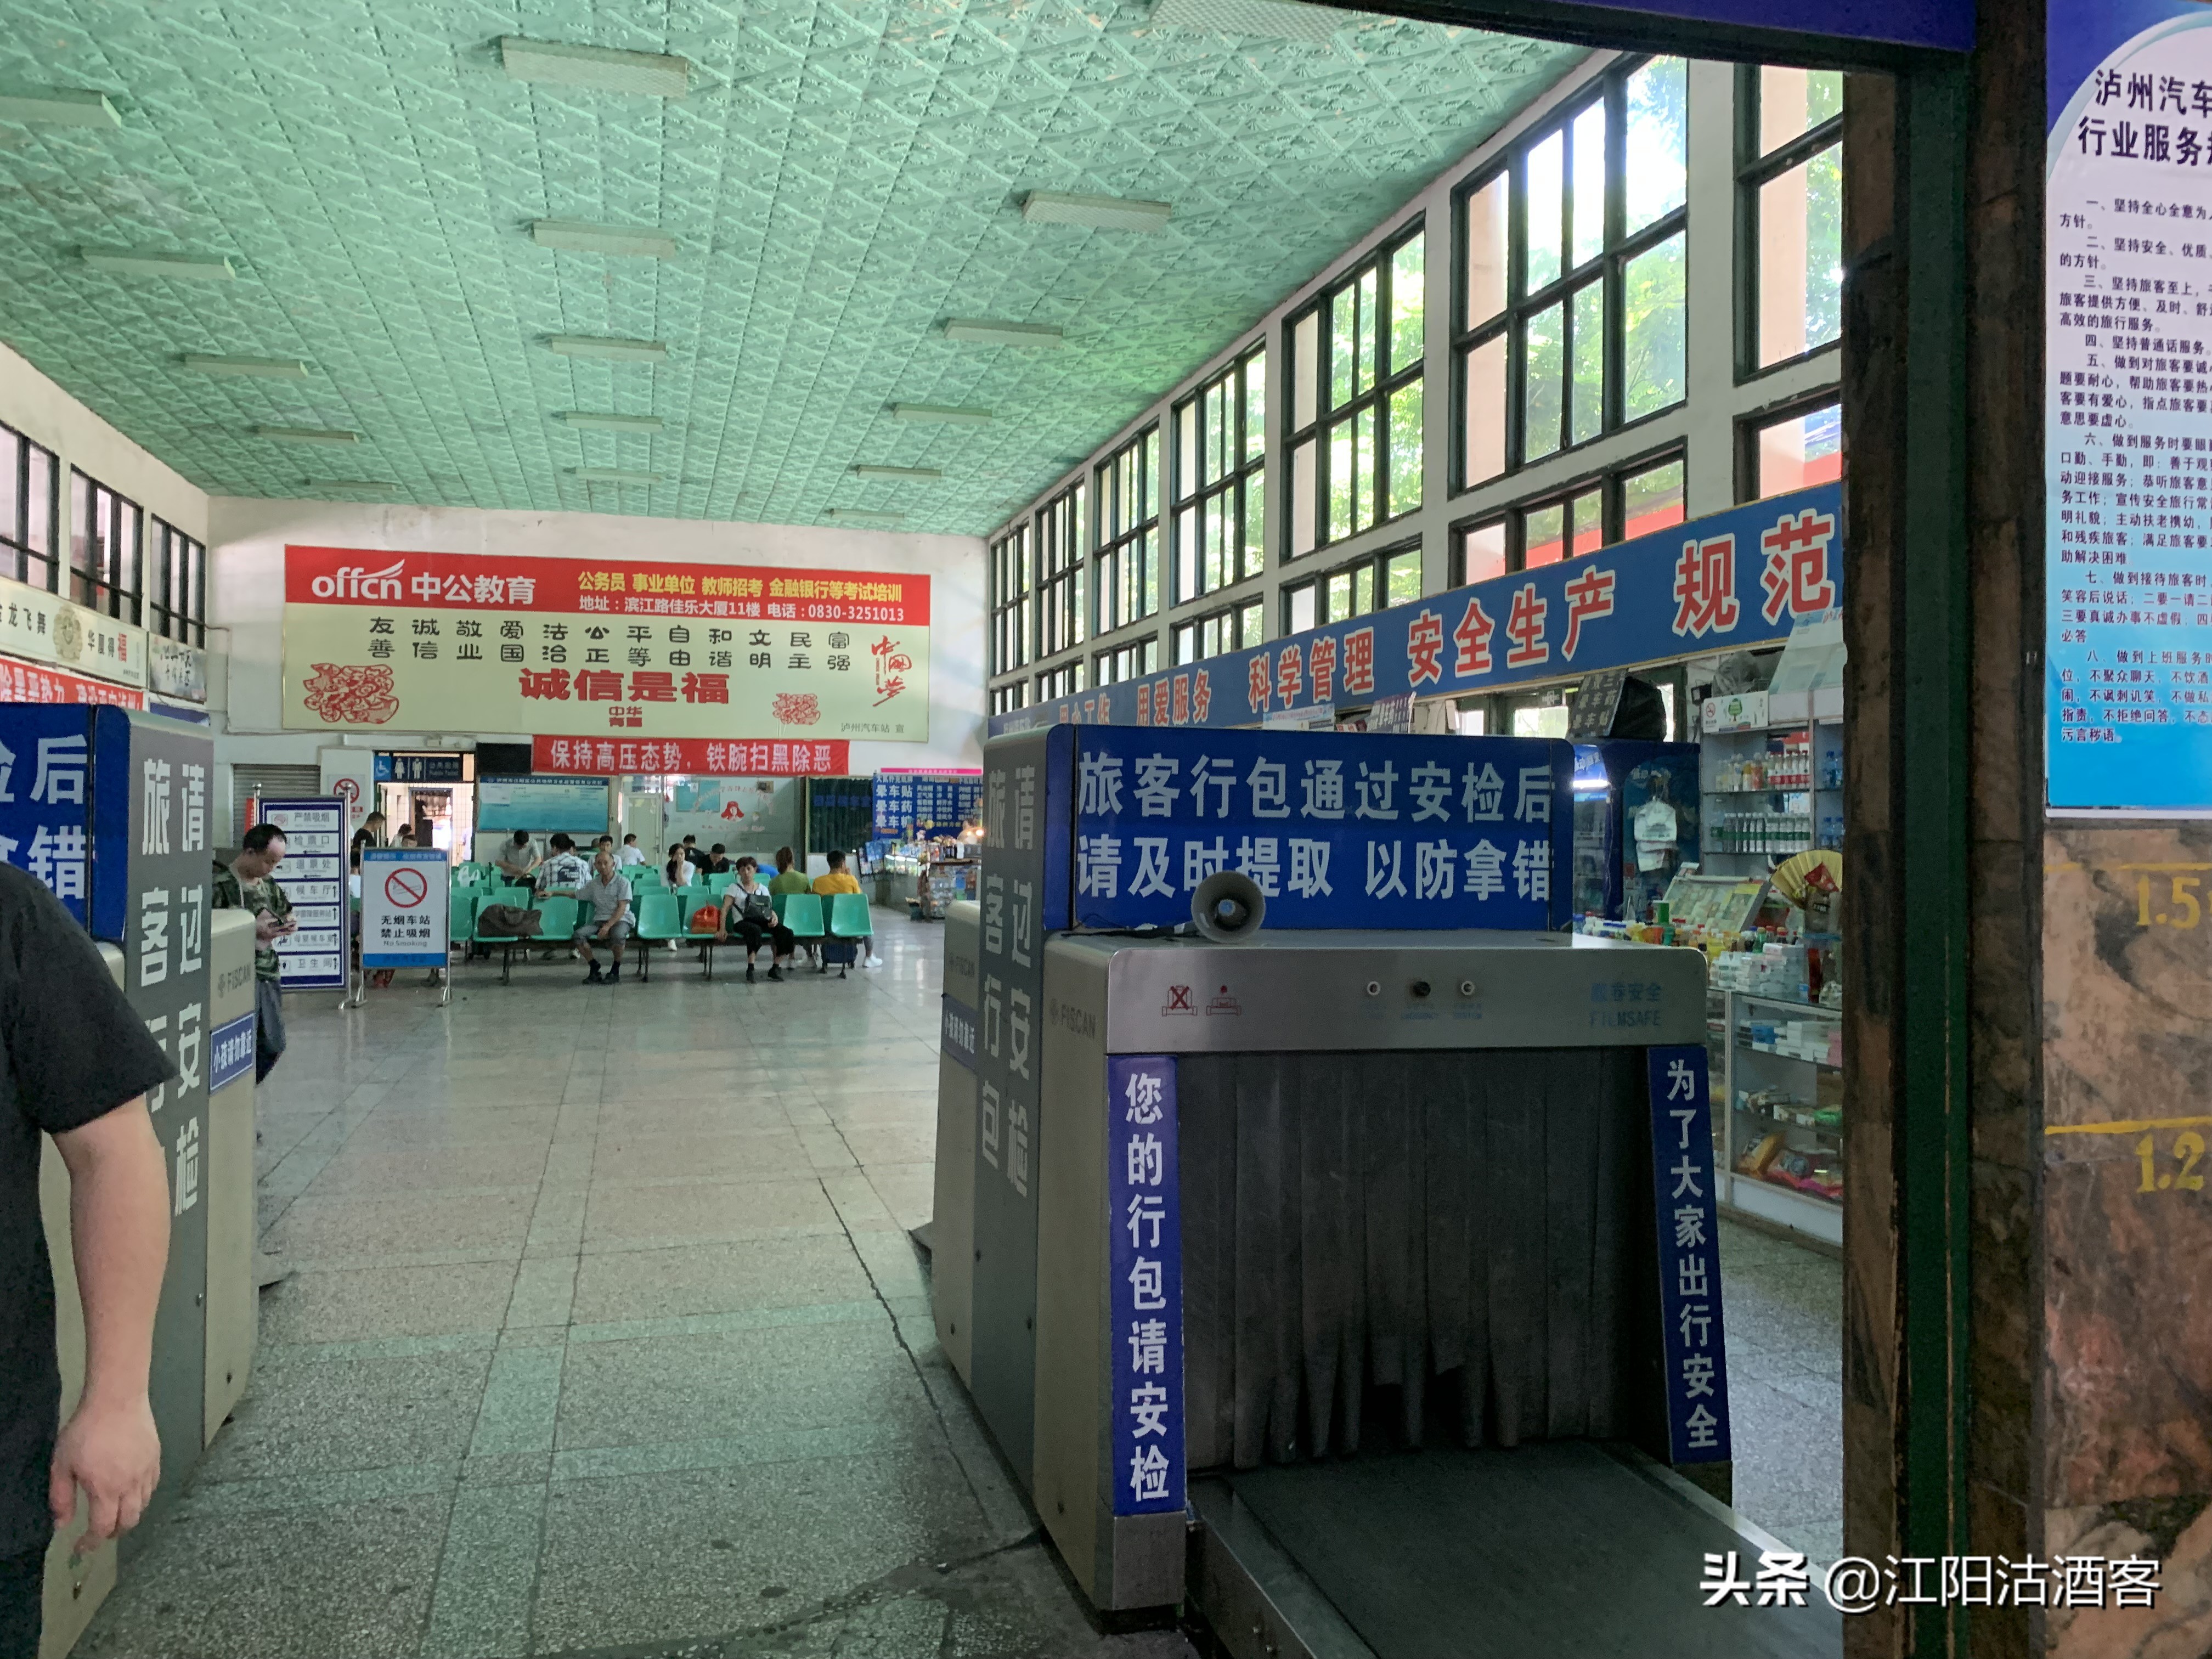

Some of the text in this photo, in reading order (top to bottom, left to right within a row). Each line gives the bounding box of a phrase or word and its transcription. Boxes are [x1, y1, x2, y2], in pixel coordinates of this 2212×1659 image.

[2095, 68, 2212, 119] 泸州汽车
[2078, 115, 2212, 166] 行业服务
[2086, 198, 2212, 219] 一、坚持全心全意为
[2059, 292, 2212, 317] 旅客提供方便、及时、舒
[2087, 353, 2212, 374] 五、做到对旅客要诚
[2060, 371, 2212, 393] 题要耐心，帮助旅客要热
[2060, 391, 2212, 413] 客要有爱心，指点旅客要
[2061, 451, 2212, 471] 口勤、手勤，即：善于观
[2061, 470, 2212, 490] 动迎接服务；恭听旅客意
[2062, 489, 2212, 510] 务工作；宣传安全旅行常
[2061, 509, 2212, 530] 明礼貌；主动扶老携幼，
[2062, 529, 2212, 549] 和残疾旅客；满足旅客要
[312, 558, 405, 600] offcn
[1672, 507, 1836, 639] 规范
[411, 572, 535, 605] 中公教育
[578, 572, 902, 602] 公务员 事业单位 教师招考 金融银行等考试培训
[2062, 589, 2212, 607] 笑容后说话；二要一请二
[1406, 564, 1616, 689] 安全生产
[2062, 609, 2212, 626] 三要真诚办事不虚假；四
[2062, 629, 2086, 644] 必答
[1249, 626, 1374, 713] 科学管理
[519, 668, 730, 704] 诚信是福
[1137, 668, 1211, 726] 用爱服务
[2062, 688, 2212, 704] 闹，不讽刺讥笑，不做私
[841, 723, 905, 733] 泸州汽车站 宣
[707, 742, 832, 773] 铁腕扫黑除恶
[1077, 751, 1555, 823] 旅客行包通过安检后
[0, 825, 95, 899] 错
[1077, 833, 1555, 902] 请及时提取 以防拿错
[381, 915, 431, 926] 无烟车站
[381, 928, 431, 938] 禁止吸烟
[2135, 1131, 2205, 1193] 1.2
[1667, 1059, 1718, 1449] 为了大家出行安全
[1125, 1072, 1169, 1503] 您的行包请安检
